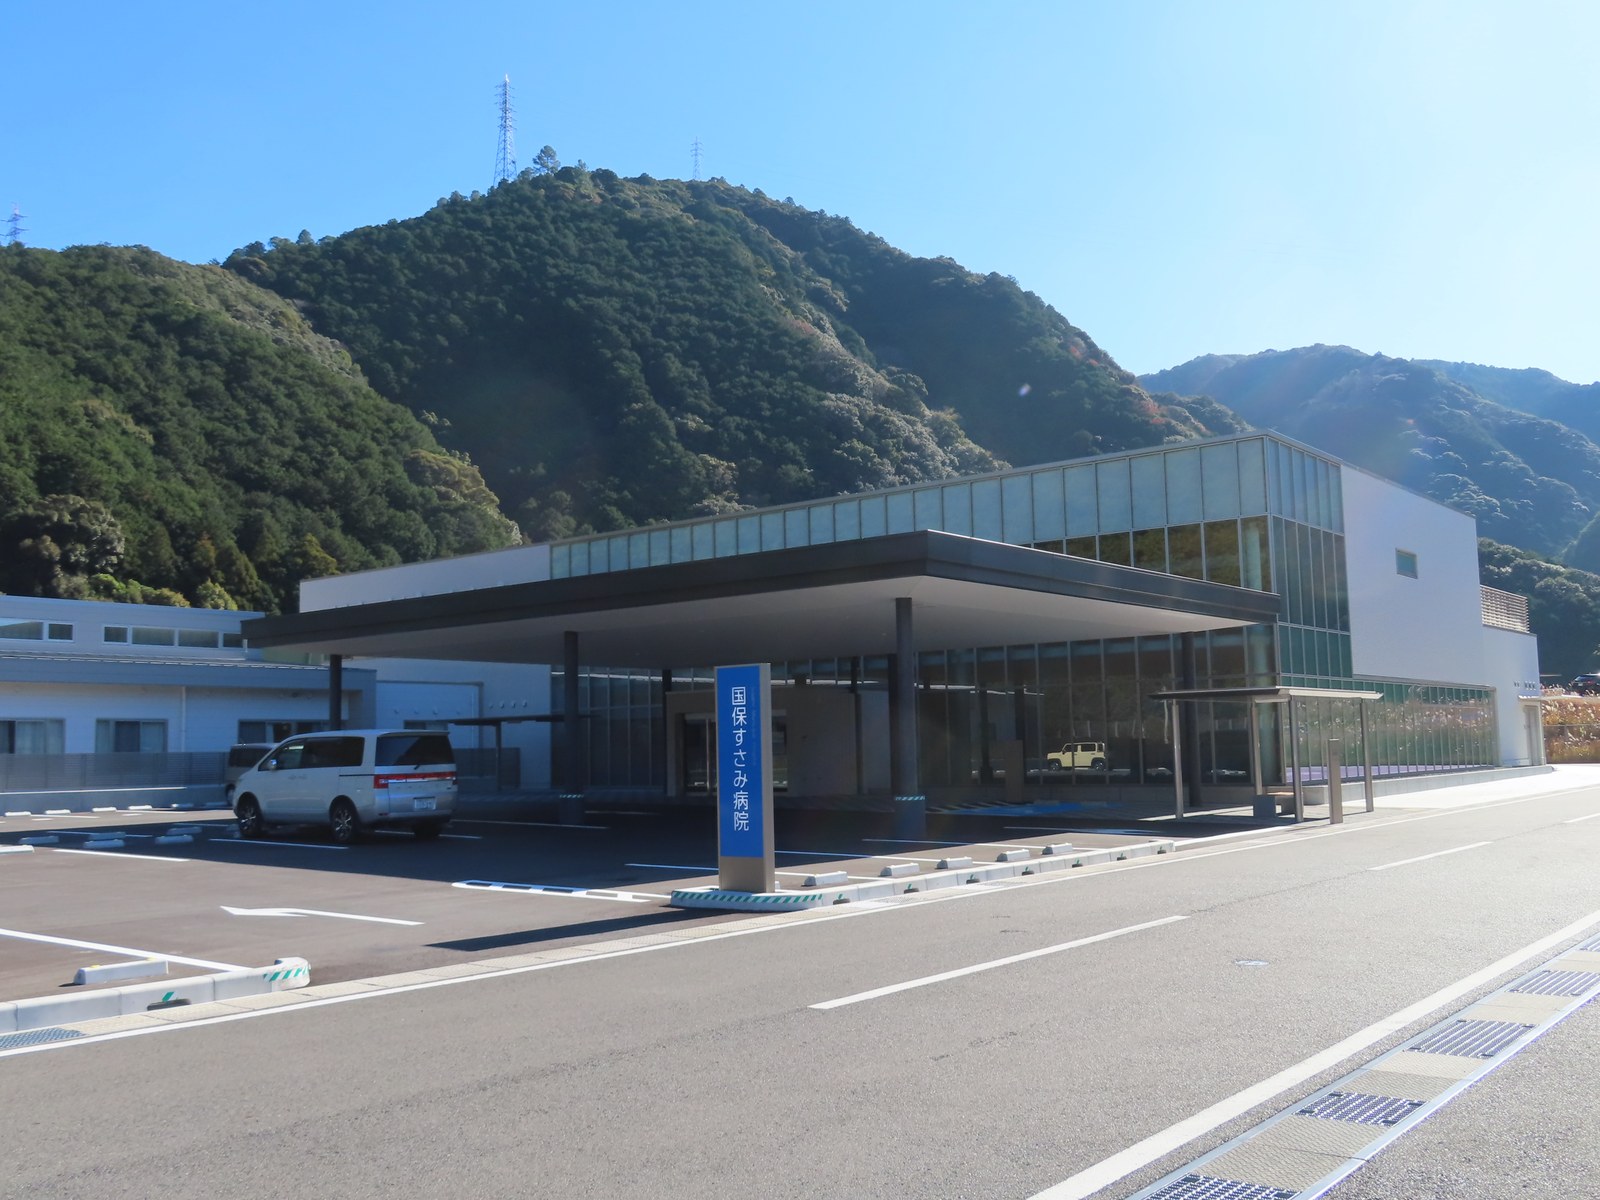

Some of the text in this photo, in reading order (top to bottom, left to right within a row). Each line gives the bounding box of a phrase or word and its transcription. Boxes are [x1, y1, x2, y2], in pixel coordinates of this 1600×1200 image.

[731, 686, 750, 832] 国保すさみ病院
